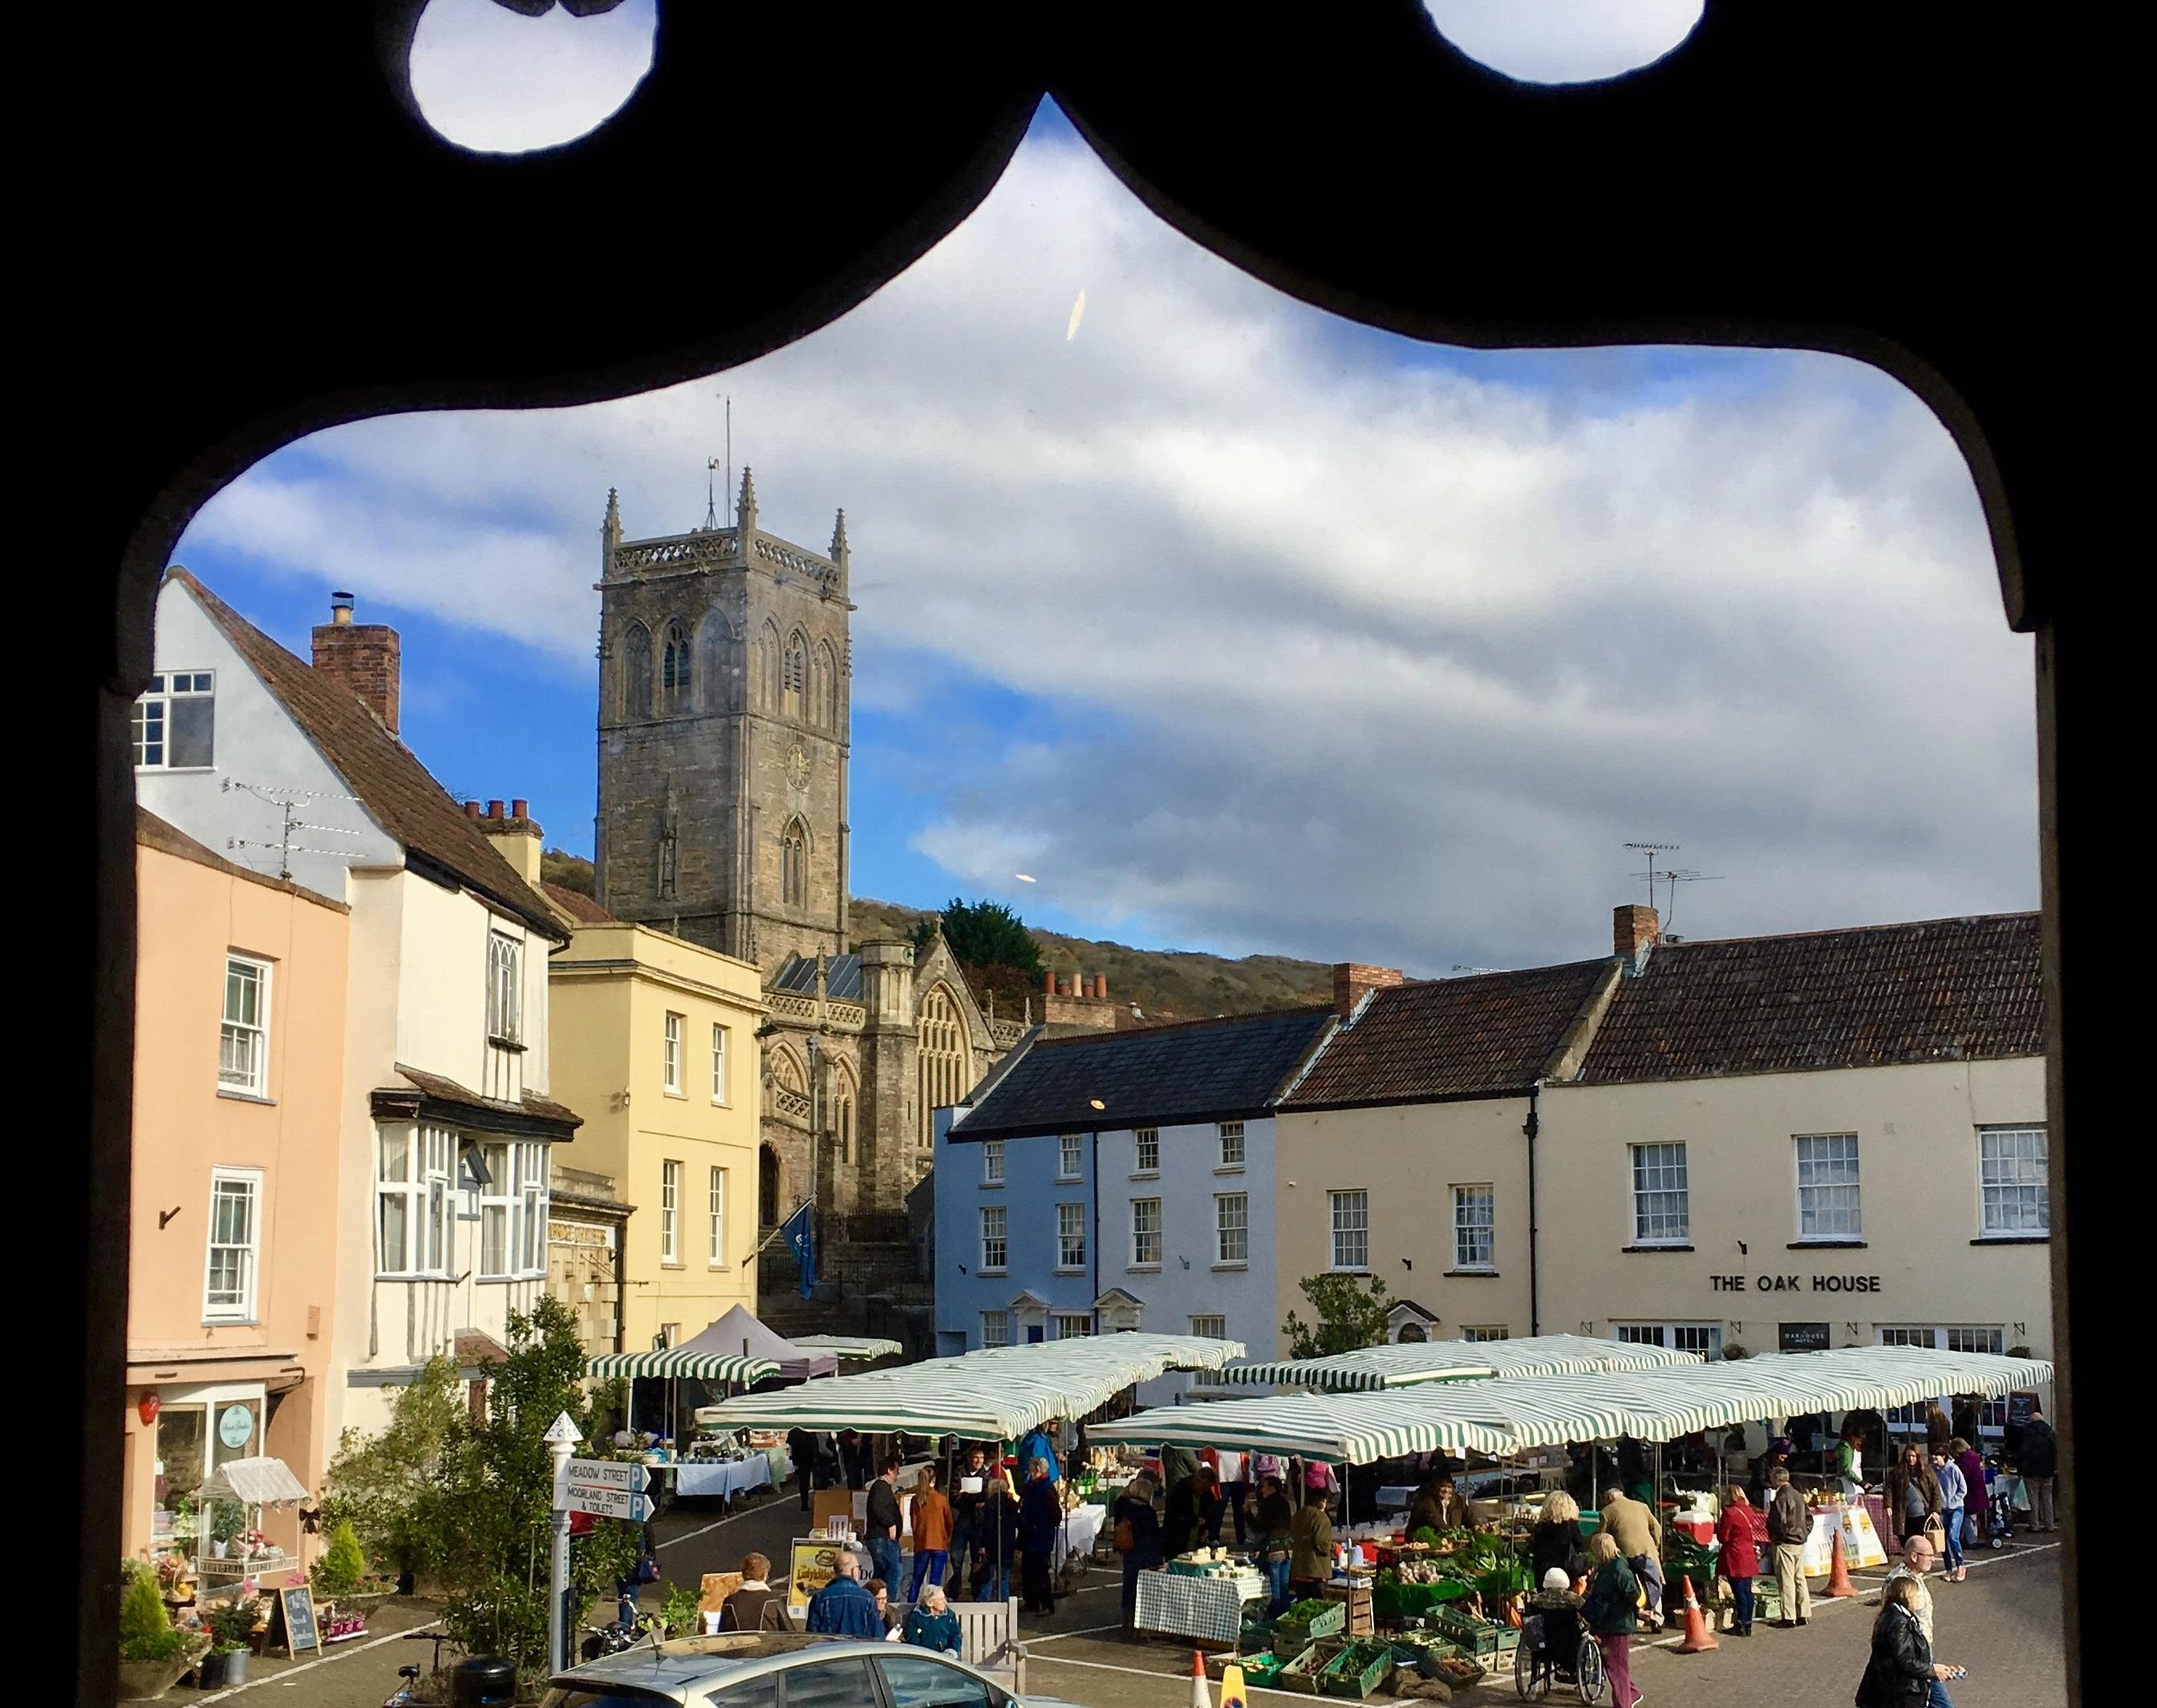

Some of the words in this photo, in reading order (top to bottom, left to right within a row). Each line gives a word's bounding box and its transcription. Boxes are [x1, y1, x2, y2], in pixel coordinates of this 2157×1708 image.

[1710, 1276, 1745, 1291] THE
[1758, 1276, 1800, 1292] OAK
[1813, 1276, 1880, 1292] HOUSE
[568, 1466, 601, 1479] MEADOW
[603, 1468, 628, 1483] STREET
[632, 1467, 640, 1489] P
[567, 1484, 602, 1500] MOORLAND
[606, 1492, 629, 1504] STREET
[582, 1501, 586, 1511] &
[590, 1502, 613, 1515] TOILETS
[633, 1497, 643, 1518] P
